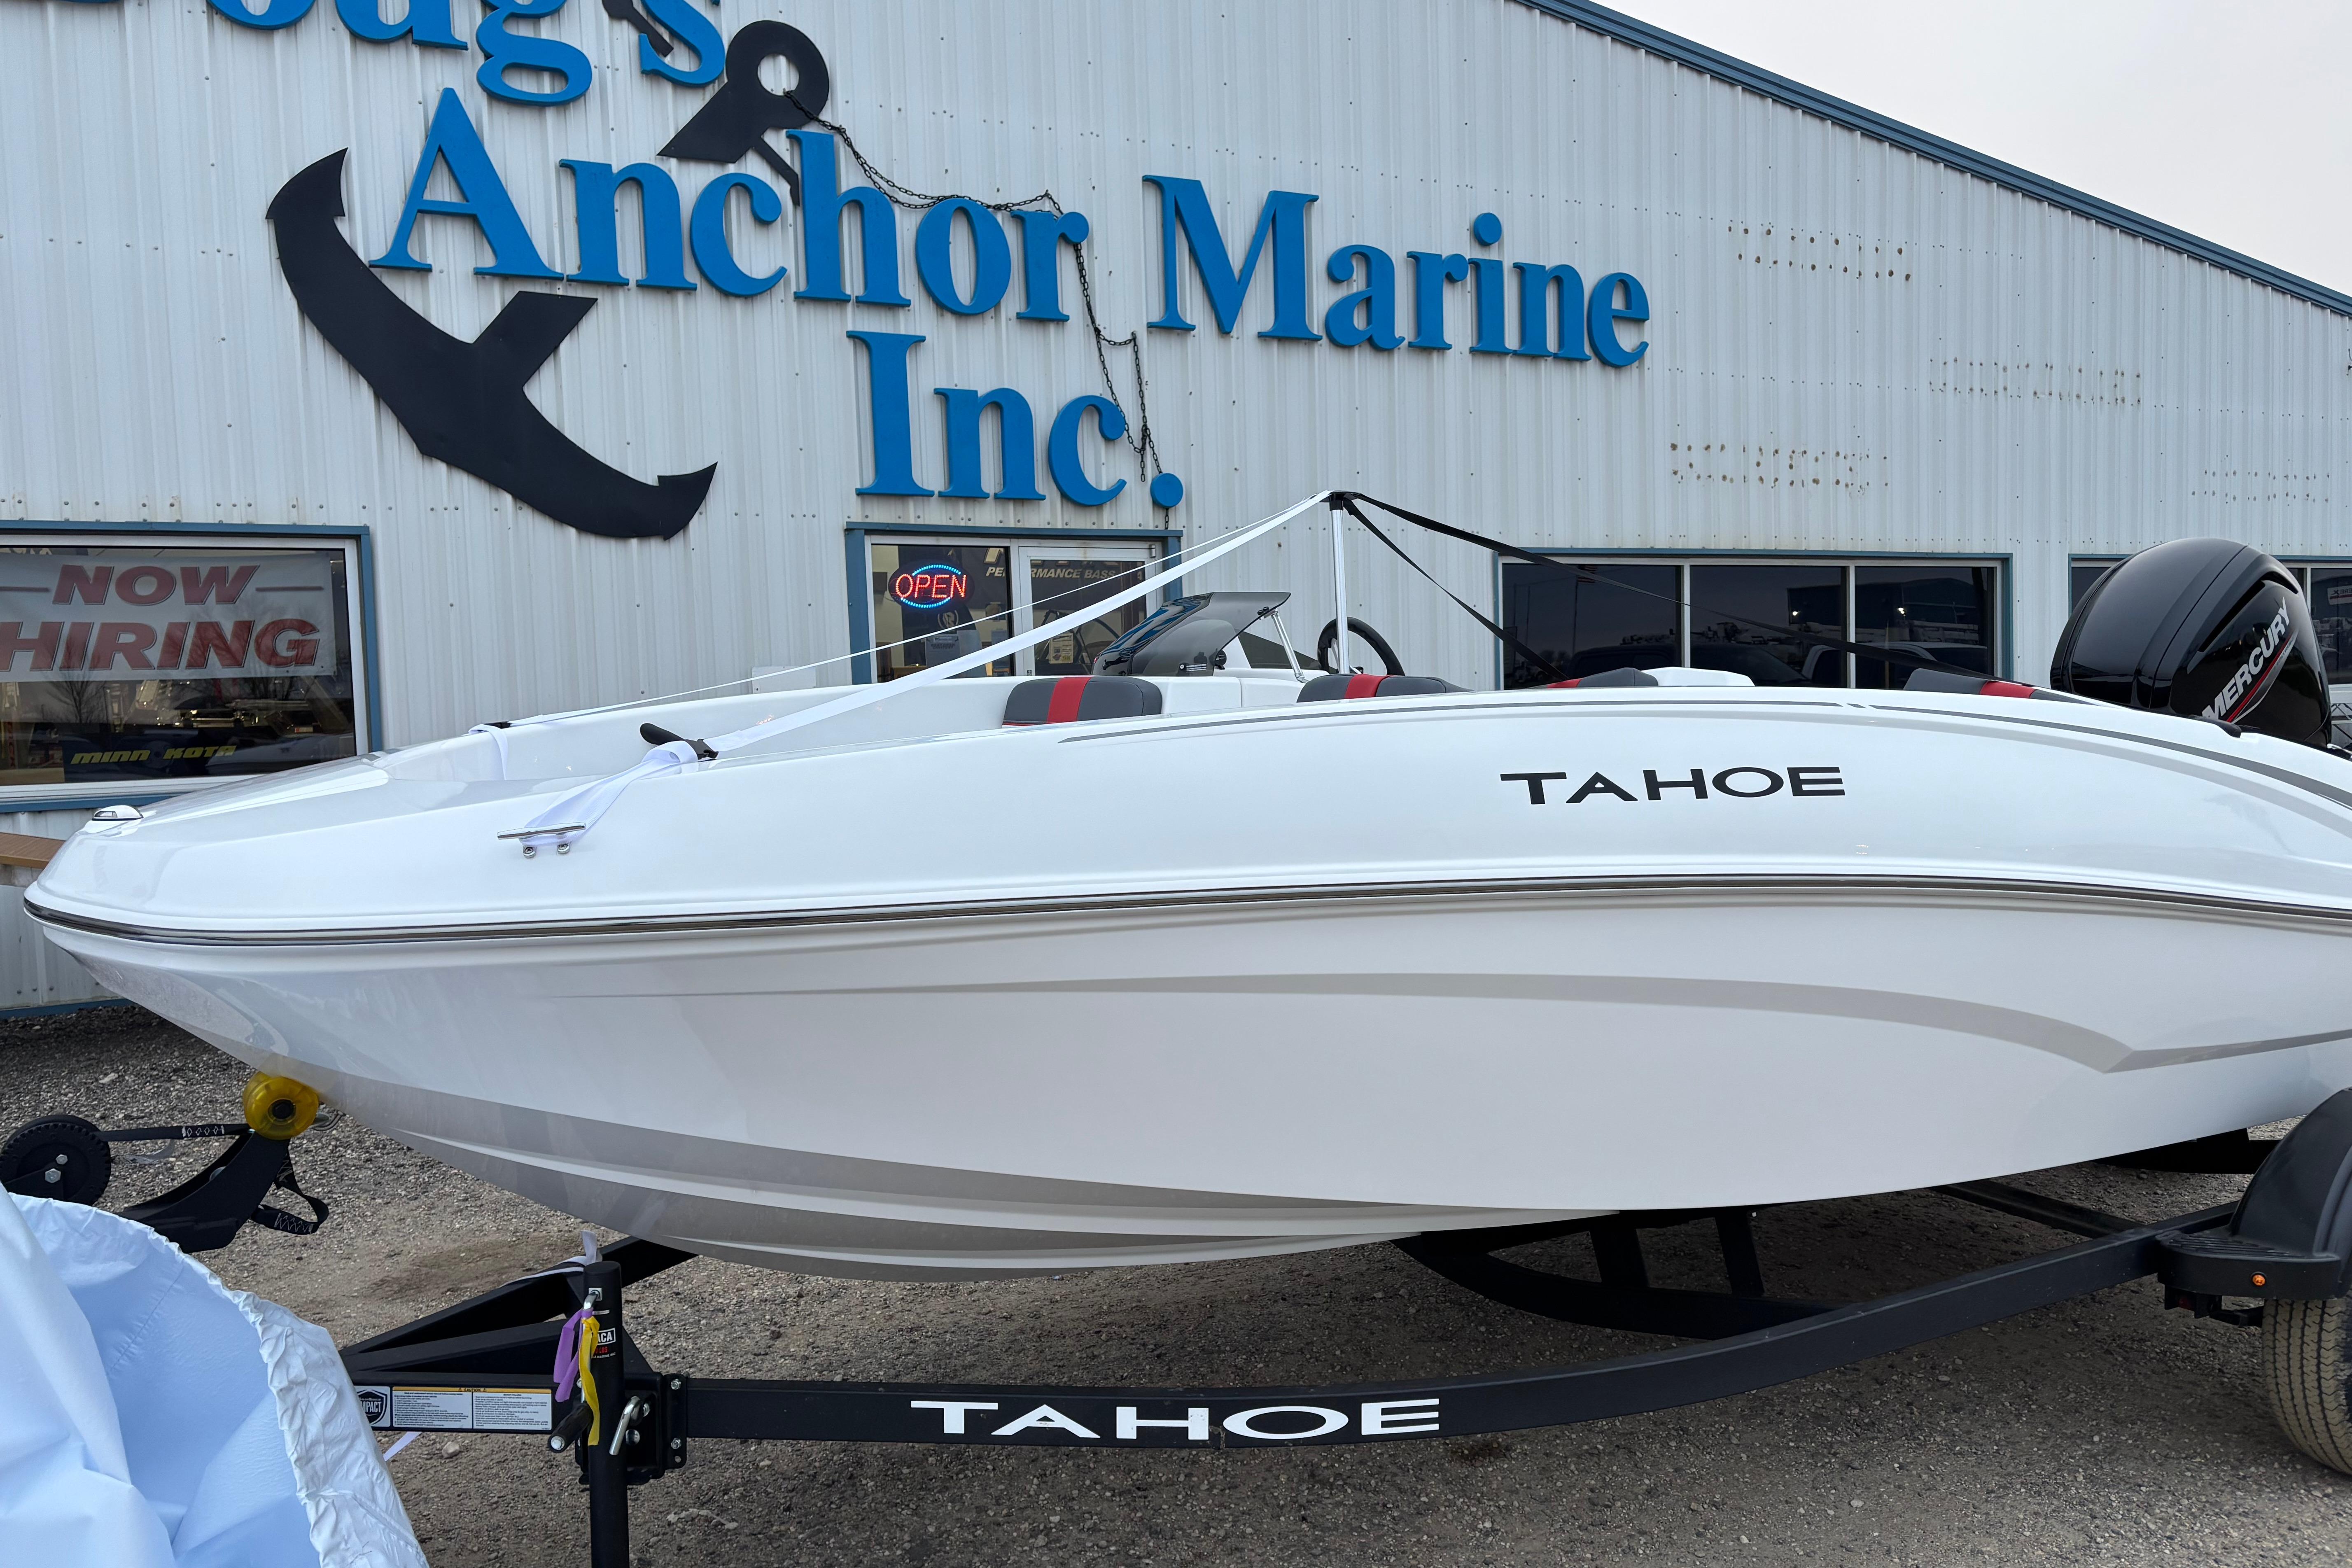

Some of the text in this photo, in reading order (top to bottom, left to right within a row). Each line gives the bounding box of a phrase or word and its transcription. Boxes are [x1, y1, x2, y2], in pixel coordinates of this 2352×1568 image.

[369, 86, 1650, 368] Anchor Marine
[846, 331, 1184, 508] Inc.
[52, 565, 260, 606] NOW
[896, 573, 967, 599] OPEN
[1084, 569, 1115, 579] BASS
[0, 618, 320, 672] HIRING
[2202, 597, 2290, 720] MERCURY
[163, 745, 236, 760] KOTA
[1500, 766, 1846, 805] TAHOE
[360, 1401, 382, 1413] MPACT
[910, 1398, 1440, 1440] TAHOE
